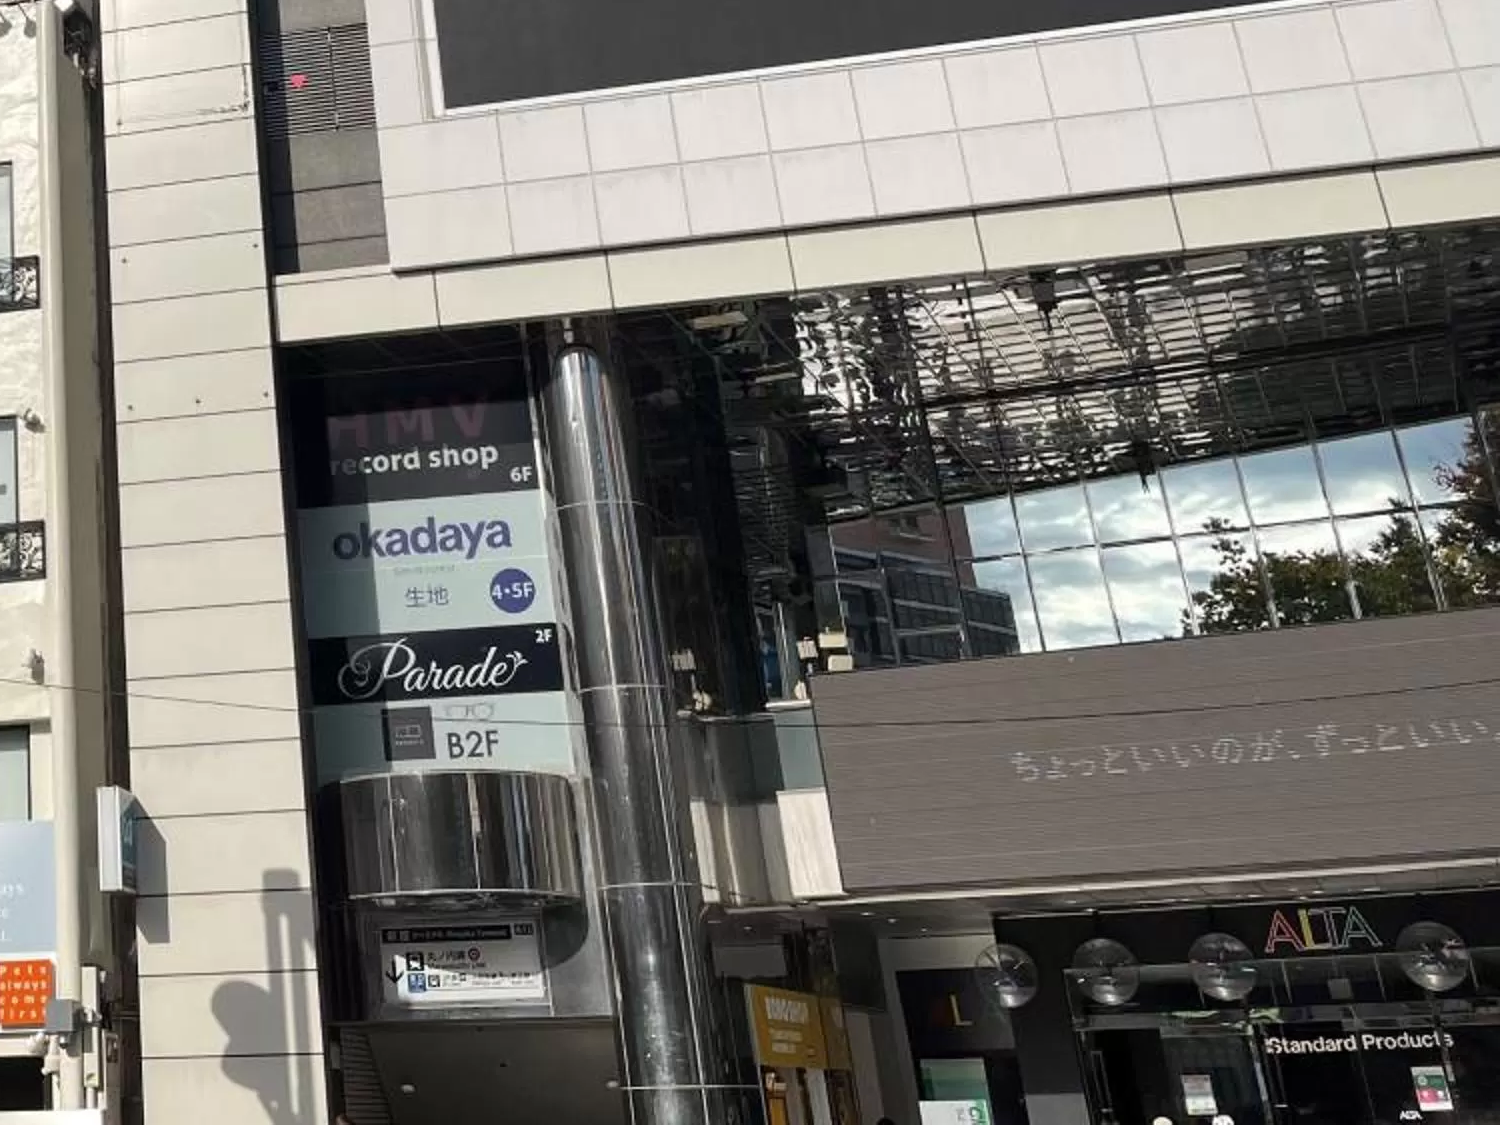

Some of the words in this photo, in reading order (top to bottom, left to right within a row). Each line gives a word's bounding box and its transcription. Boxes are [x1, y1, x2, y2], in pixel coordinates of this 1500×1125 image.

[329, 445, 422, 476] record
[428, 442, 500, 471] shop
[509, 465, 534, 484] 6F
[332, 515, 514, 561] okadaya
[404, 585, 450, 608] 生地
[534, 628, 553, 644] 2F
[337, 636, 529, 700] Parade
[447, 730, 500, 760] B2F
[1264, 906, 1384, 954] ALTA
[1266, 1035, 1358, 1056] Standard
[1360, 1031, 1455, 1051] Products
